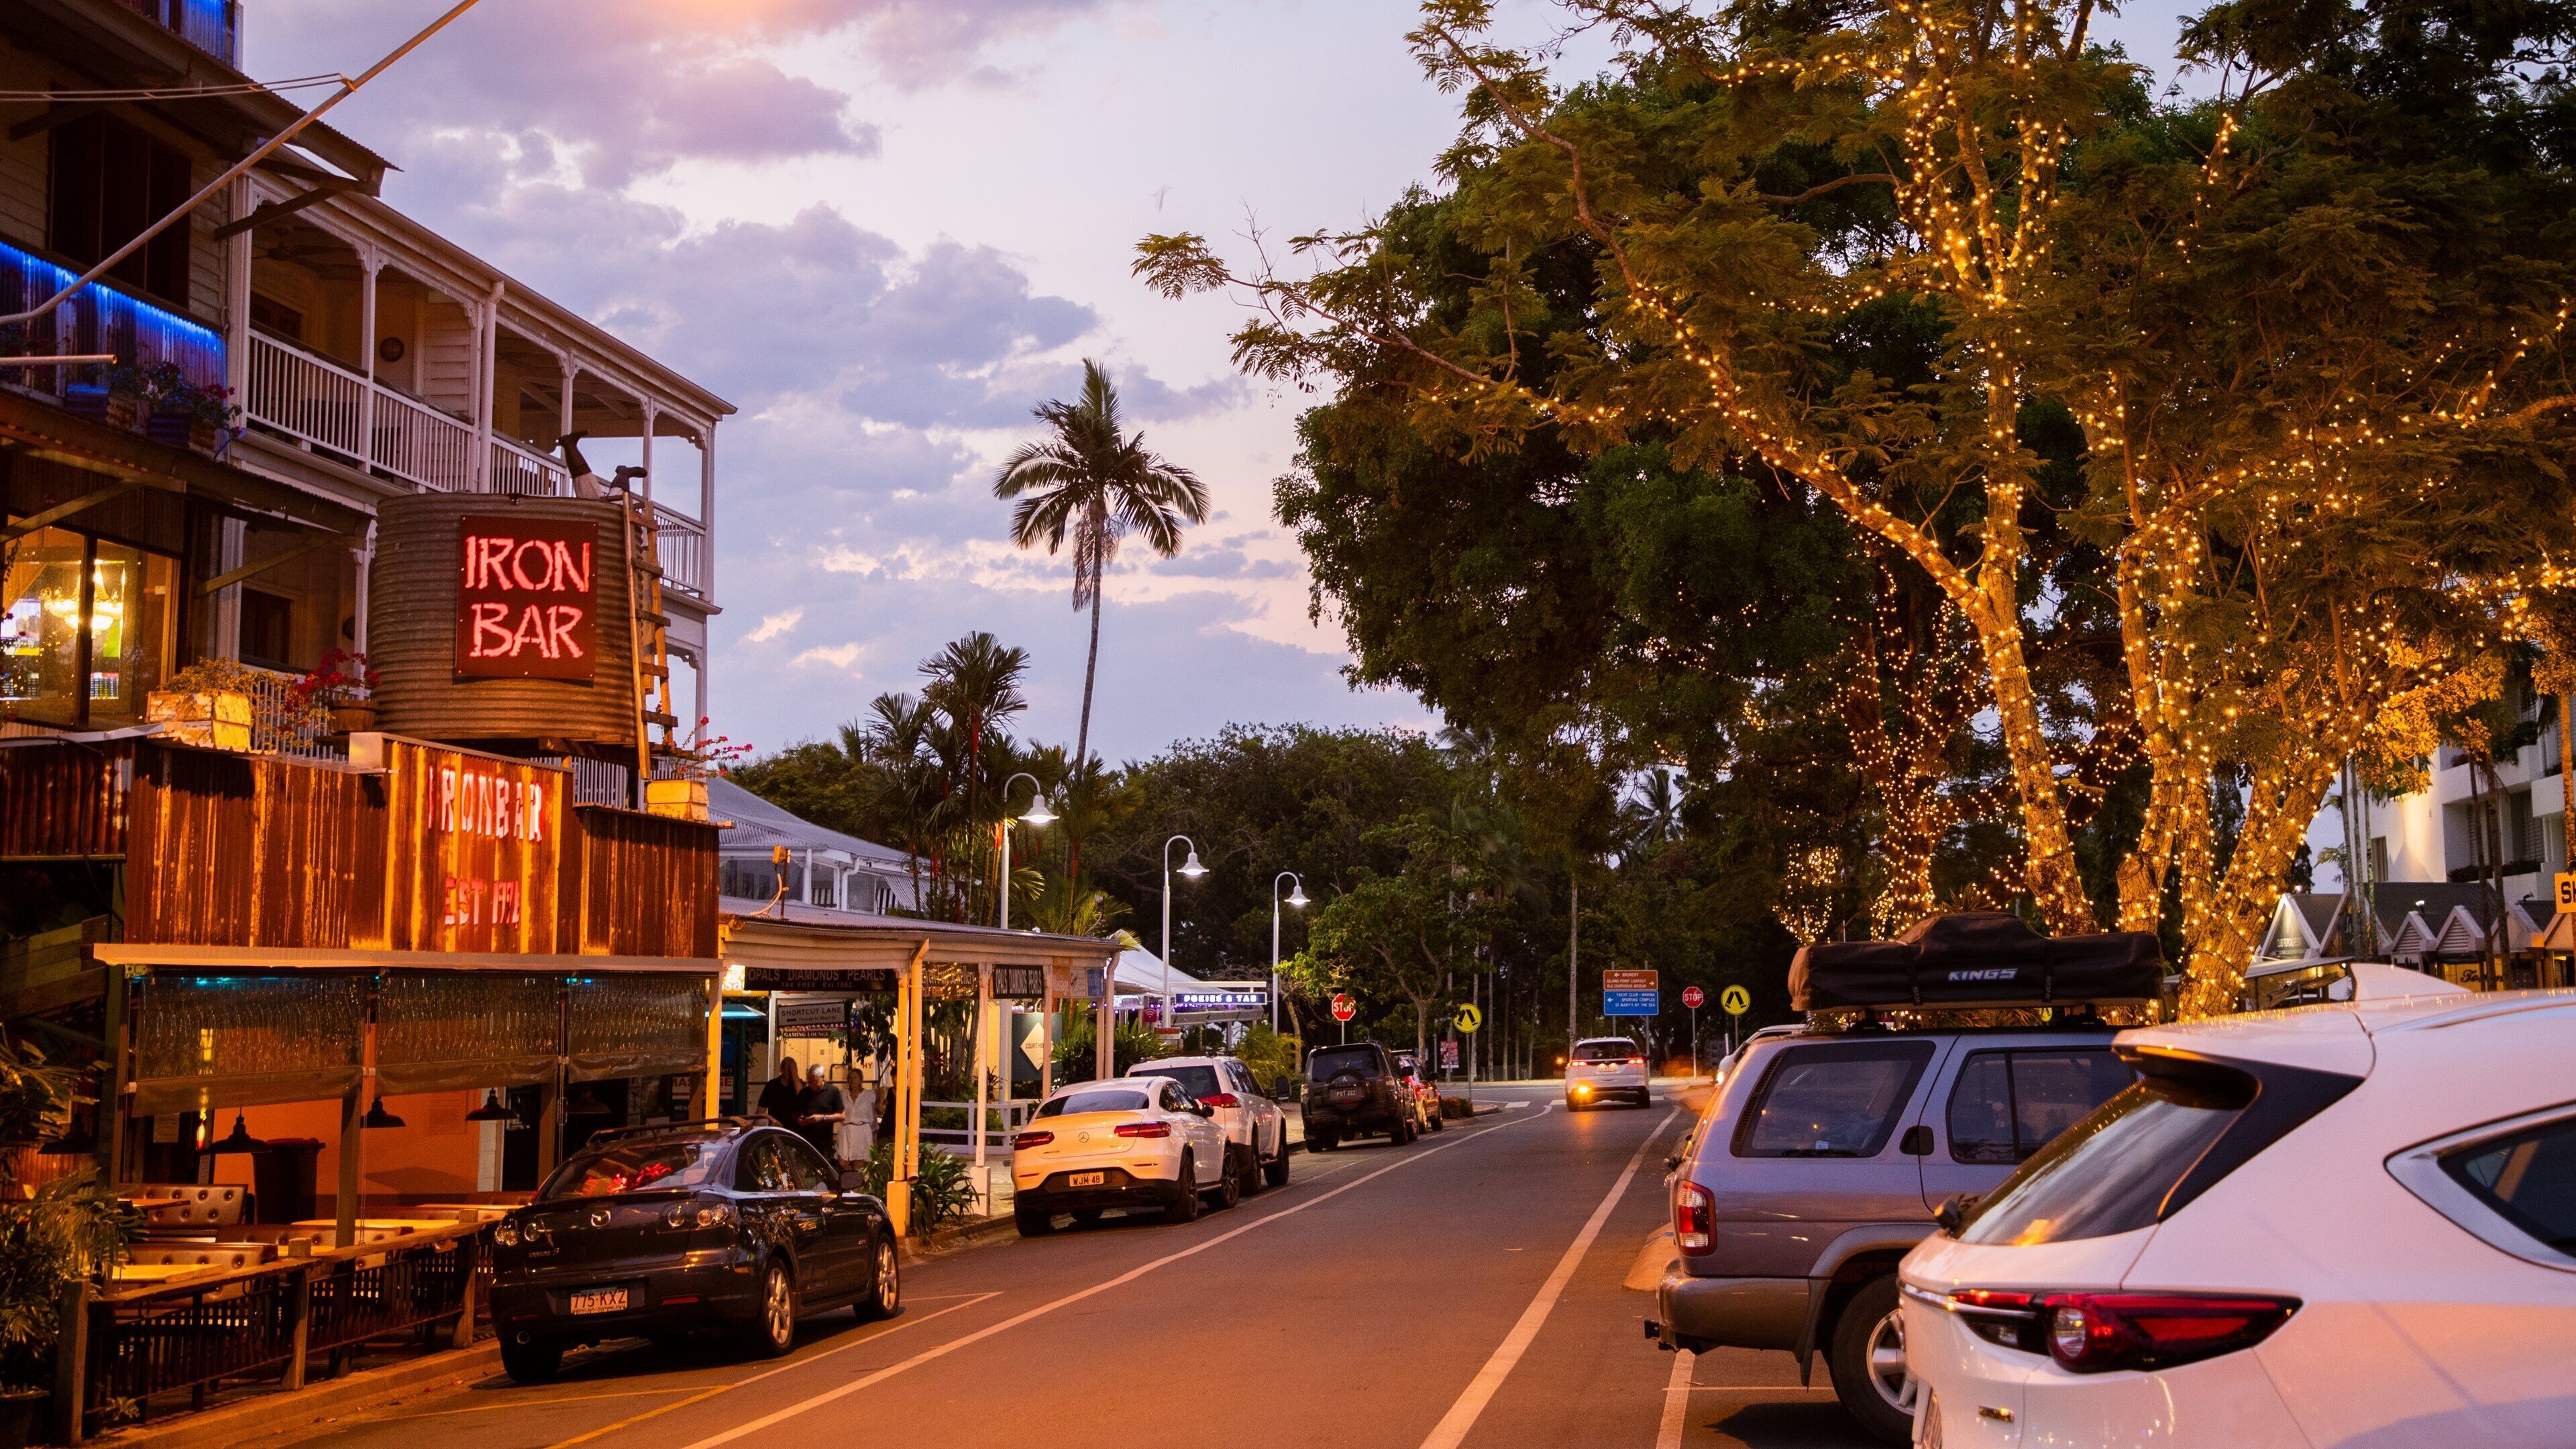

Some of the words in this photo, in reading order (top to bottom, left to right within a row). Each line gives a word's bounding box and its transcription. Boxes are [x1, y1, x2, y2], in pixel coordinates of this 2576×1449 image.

[465, 535, 590, 592] IRON
[470, 603, 584, 658] BAR
[445, 877, 484, 926] EST
[749, 969, 780, 981] OPALS
[788, 969, 839, 981] DIAMONDS
[847, 968, 885, 981] PEARLS
[1948, 968, 2018, 981] KINGS
[1183, 994, 1222, 1003] POKIES
[1236, 994, 1257, 1003] TAB
[1684, 993, 1702, 1002] STOP
[782, 1008, 819, 1016] SHORTCUT
